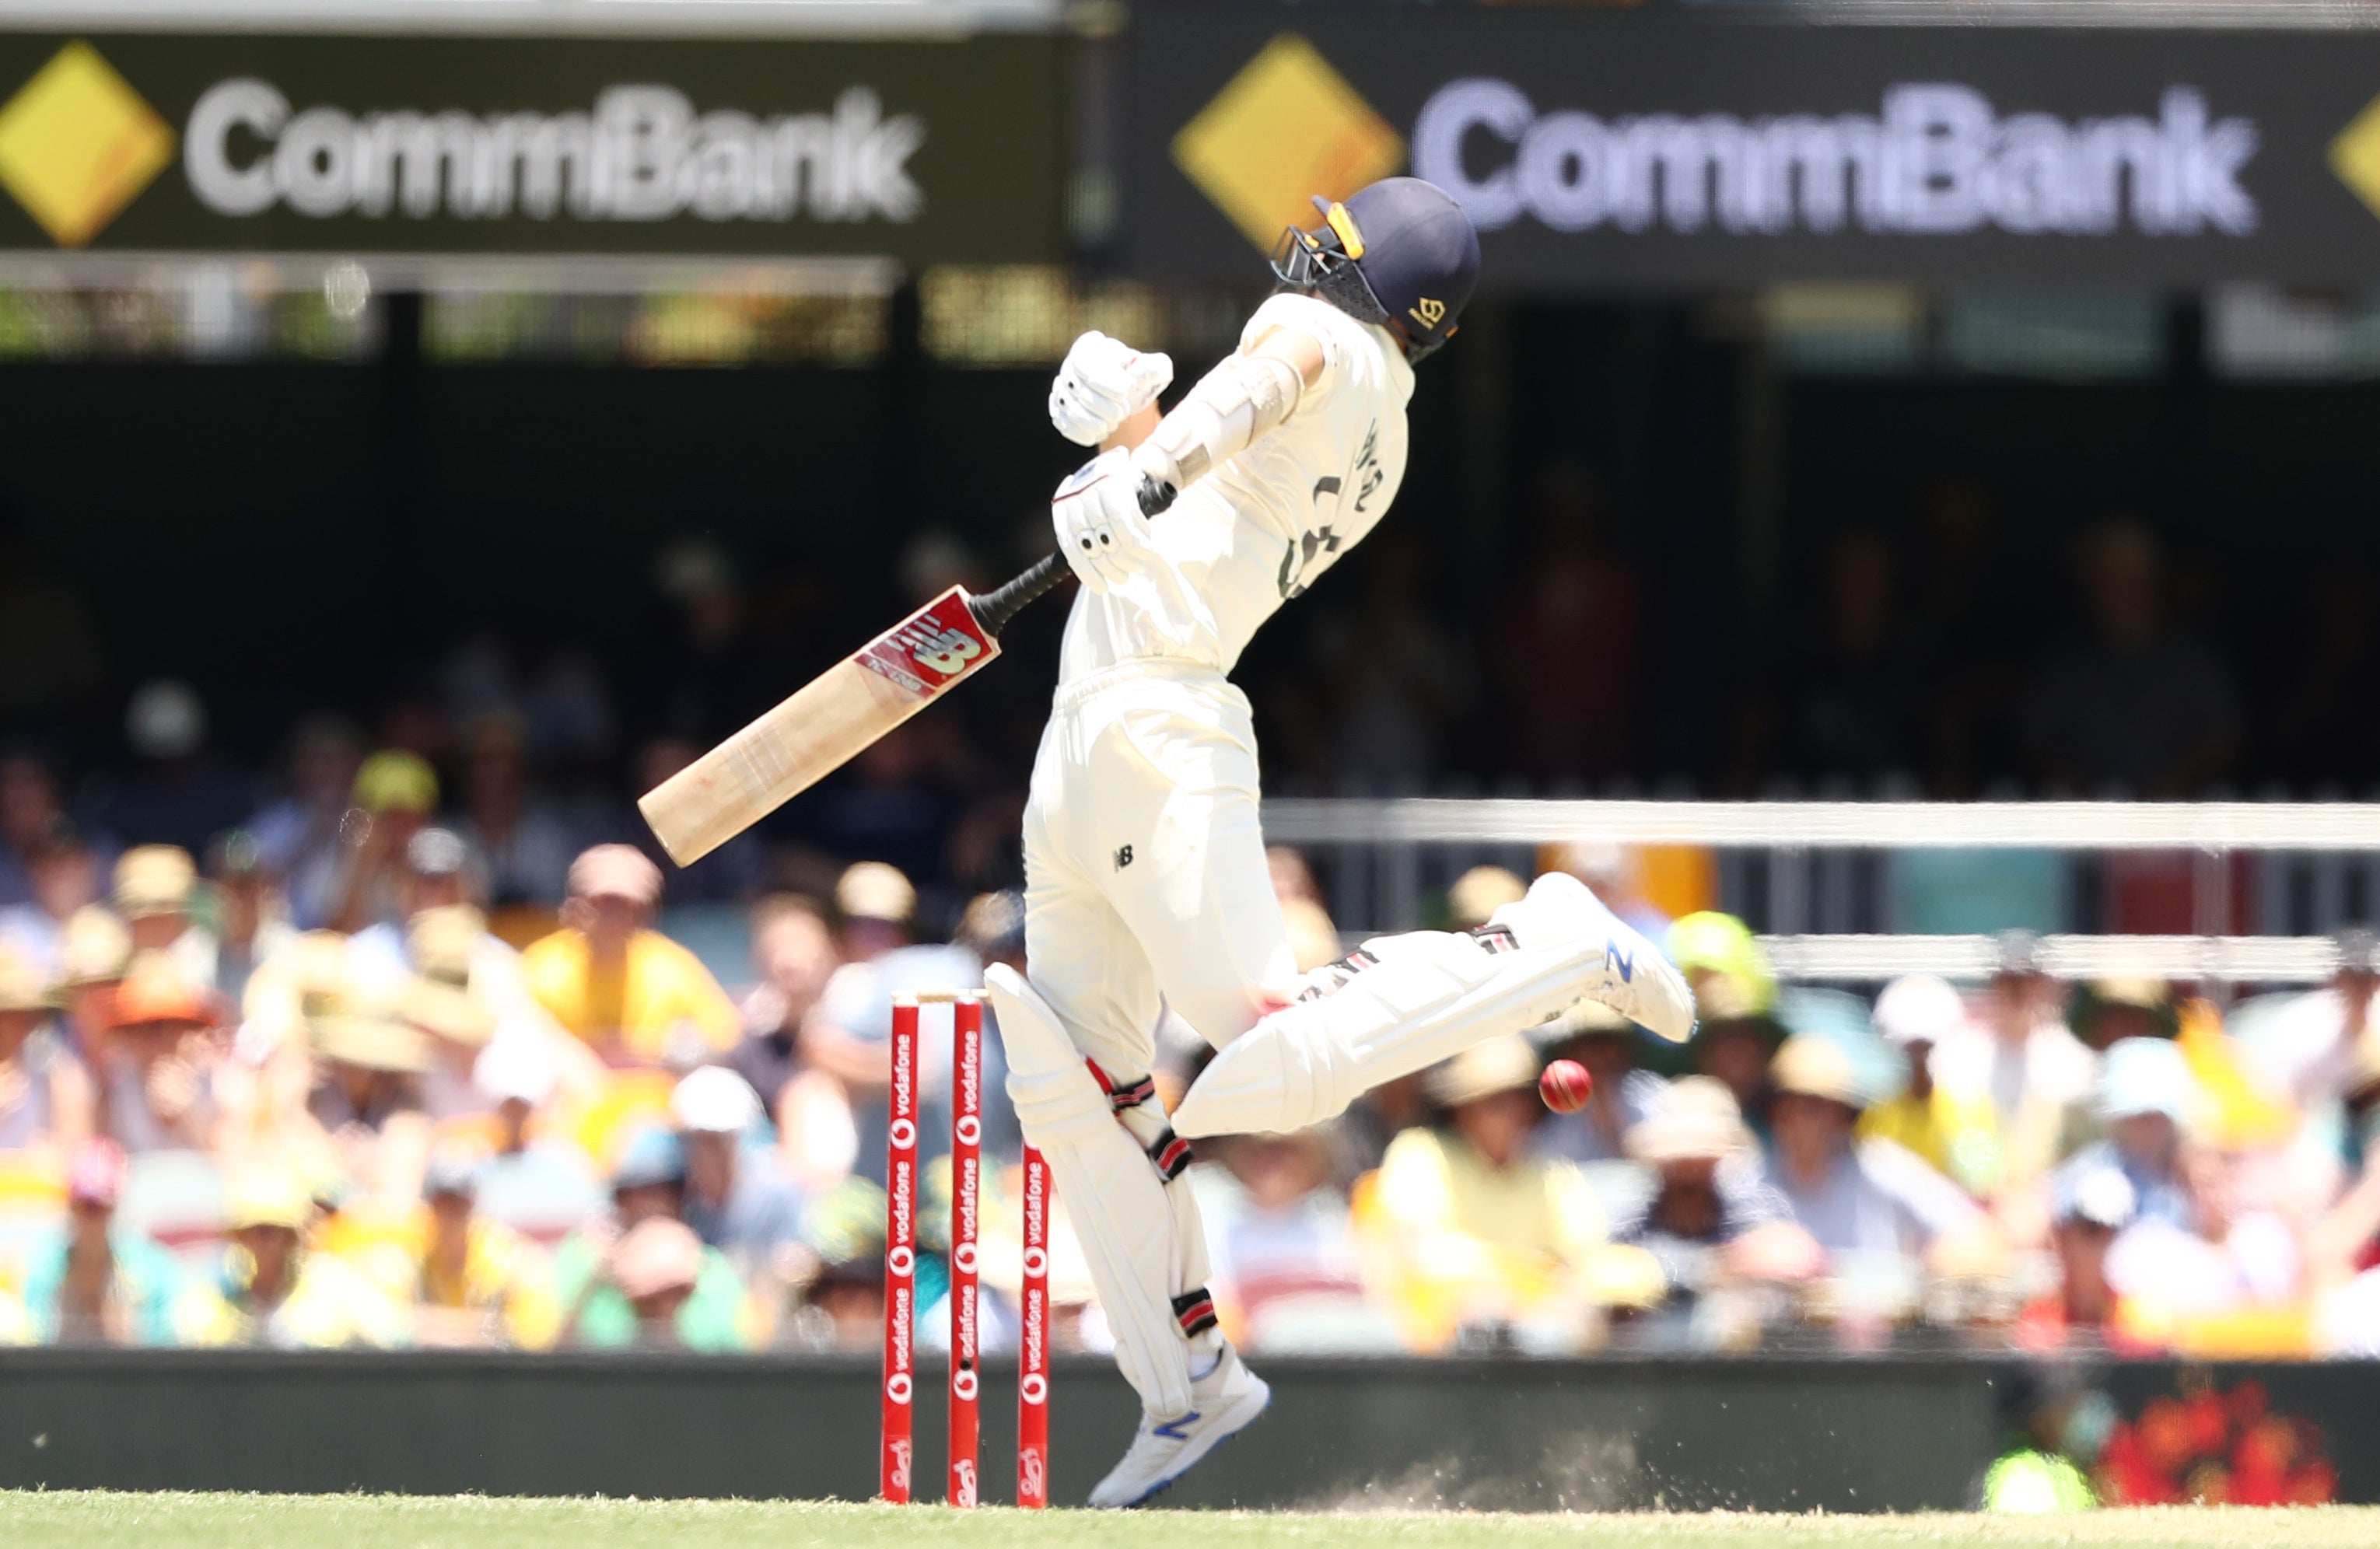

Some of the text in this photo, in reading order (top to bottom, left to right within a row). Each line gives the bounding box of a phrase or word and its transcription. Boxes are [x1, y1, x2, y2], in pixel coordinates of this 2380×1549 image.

[184, 78, 922, 221] CommBank
[1412, 78, 2260, 238] CommBank
[894, 1034, 911, 1116] vodafone
[961, 1030, 978, 1114] vodafone
[894, 1161, 910, 1244] vodafone
[960, 1158, 977, 1241] vodafone
[1027, 1162, 1044, 1246] vodafone
[892, 1288, 910, 1371] vodafone
[959, 1285, 975, 1361] odafone
[1026, 1289, 1043, 1371] vodafone
